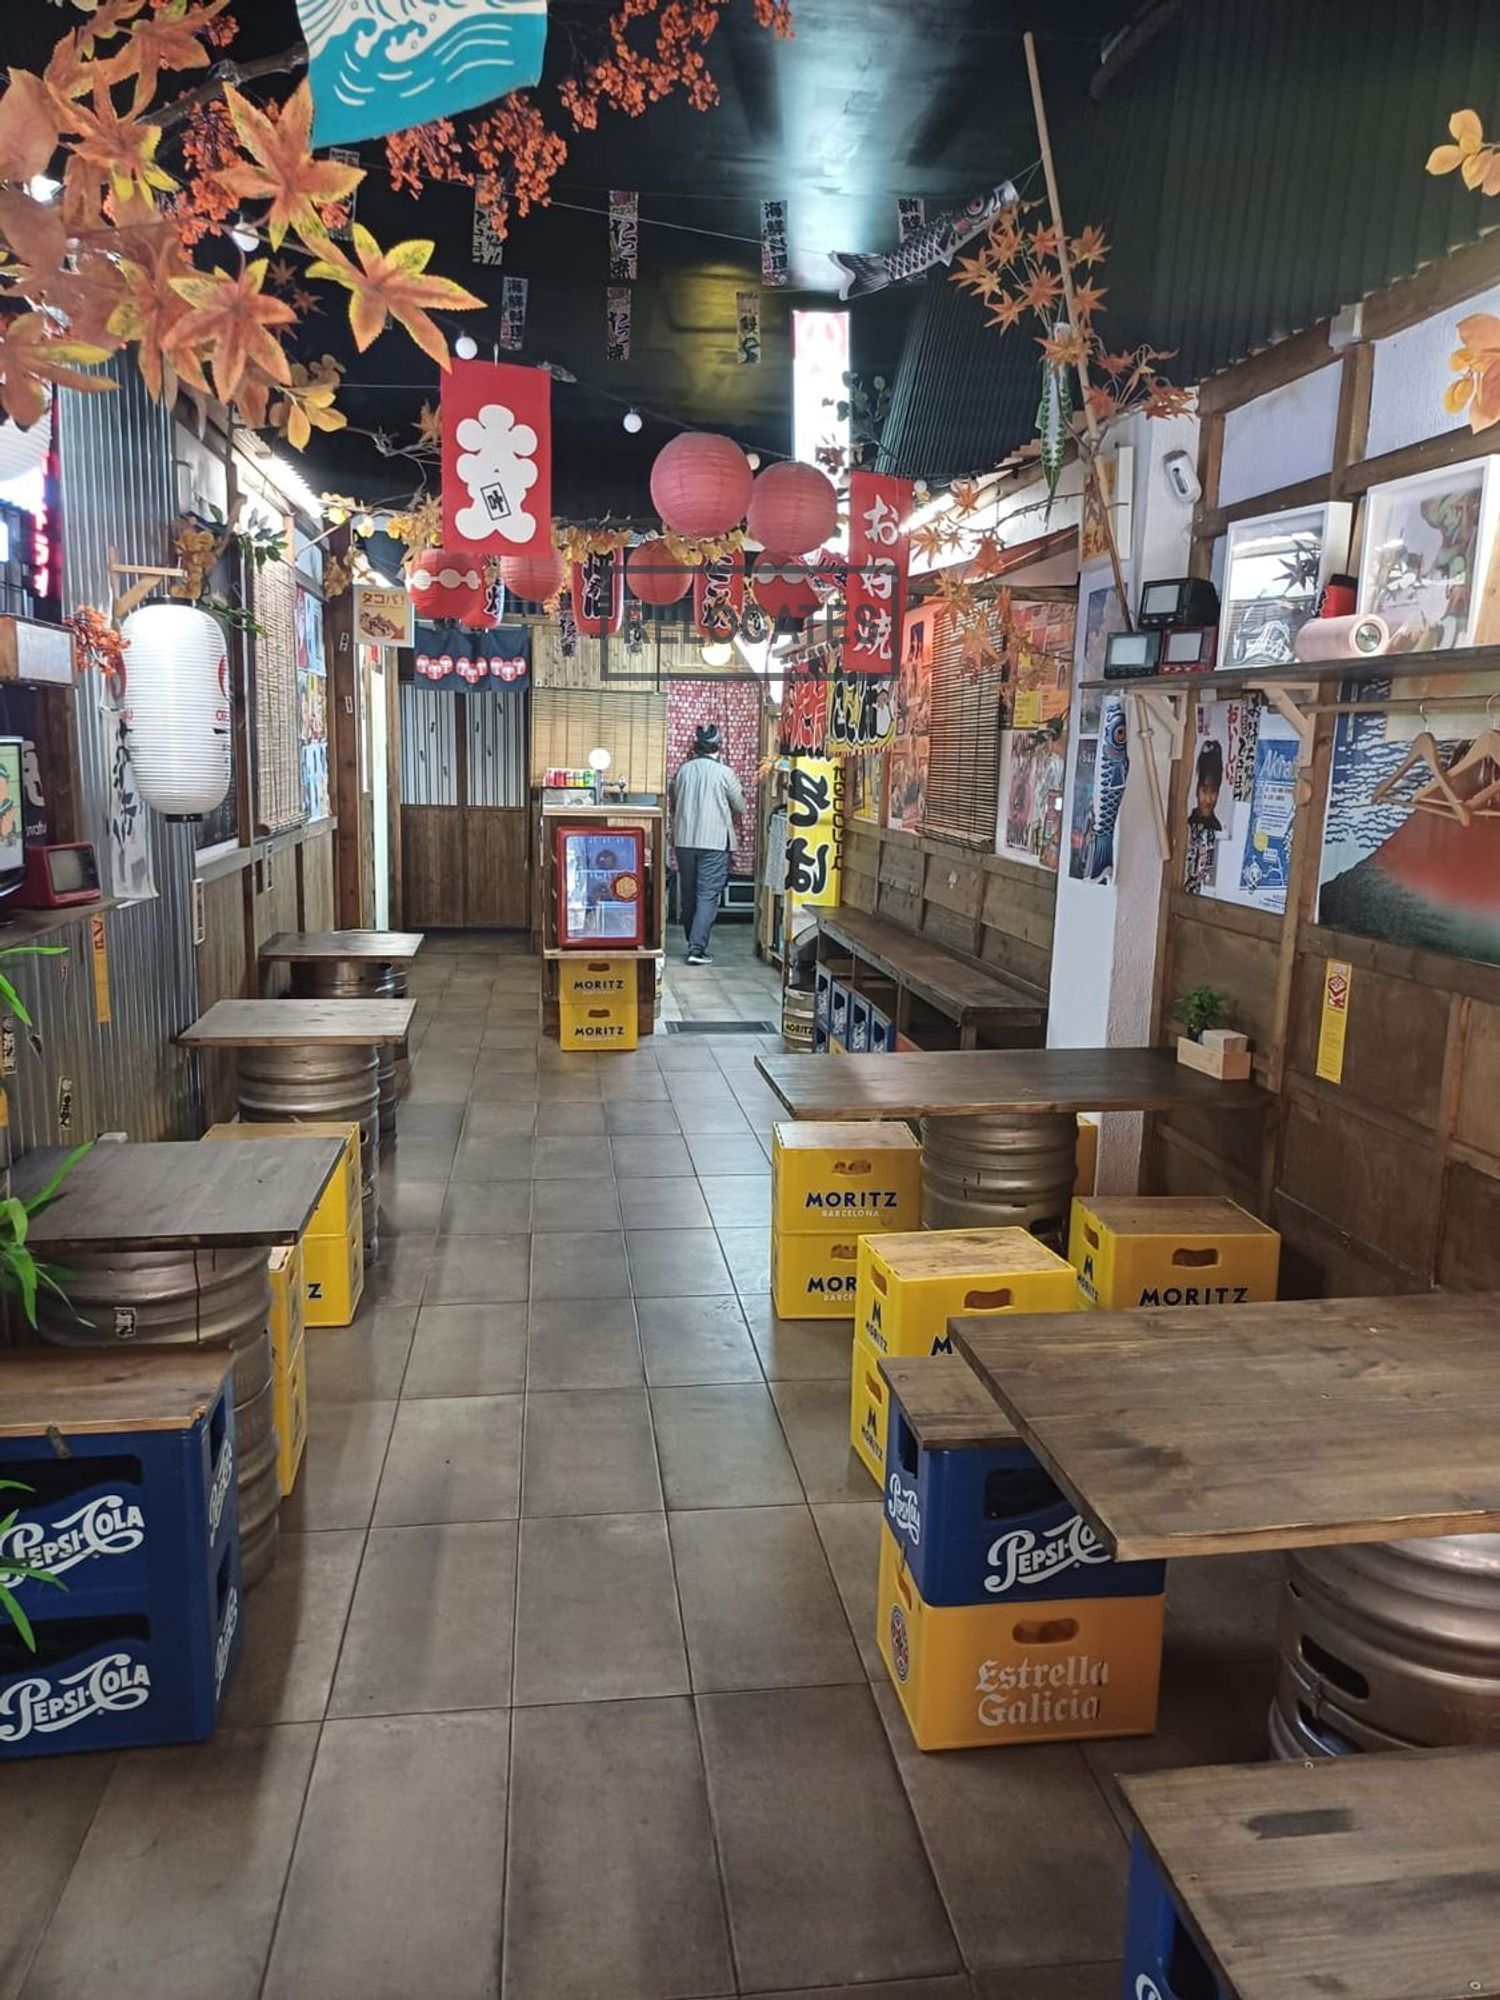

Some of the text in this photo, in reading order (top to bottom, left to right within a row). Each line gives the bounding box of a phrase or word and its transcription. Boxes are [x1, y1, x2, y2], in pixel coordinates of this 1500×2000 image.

[853, 493, 900, 660] お好焼
[573, 980, 625, 990] MORITZ
[574, 1026, 625, 1036] MORITZ
[806, 1192, 897, 1208] MORITZ
[822, 1209, 880, 1217] BARCELONA
[1139, 1287, 1249, 1307] MORITZ
[865, 1320, 888, 1354] MORITZ
[861, 1423, 884, 1461] MORITZ
[975, 1655, 1110, 1693] Estrella
[978, 1689, 1101, 1727] Galicia
